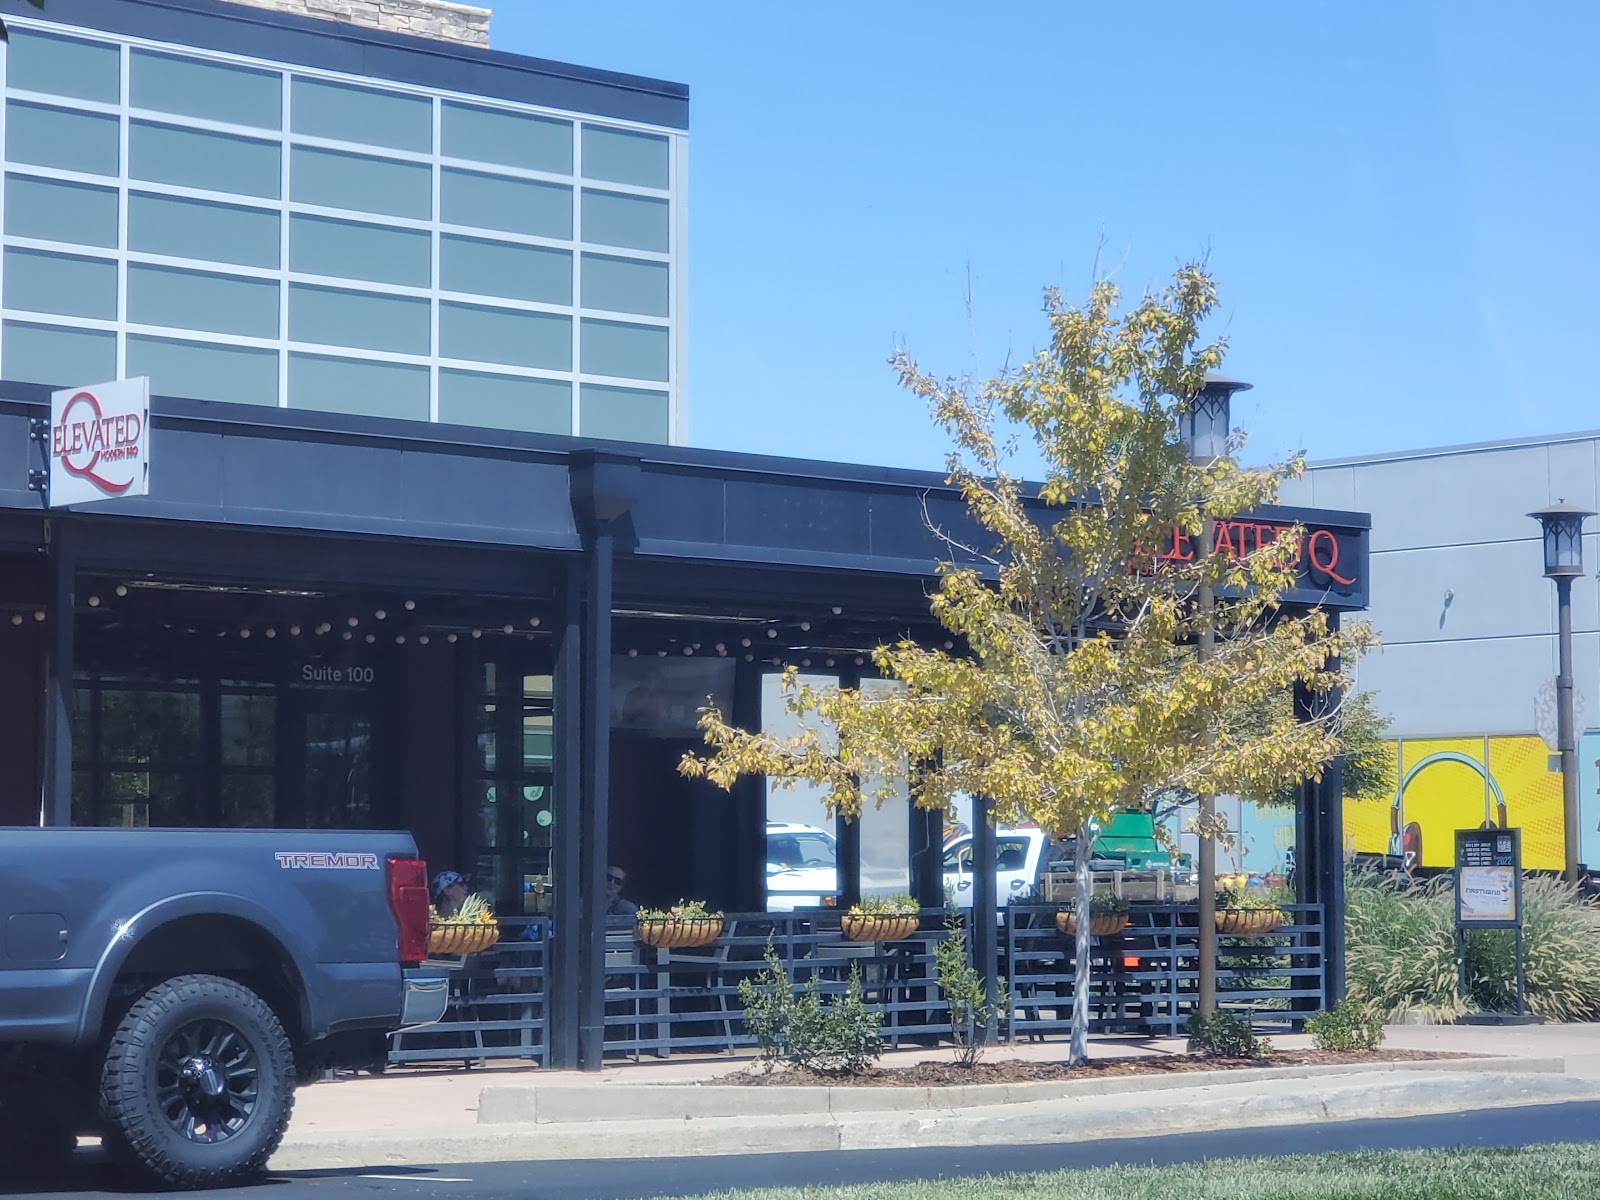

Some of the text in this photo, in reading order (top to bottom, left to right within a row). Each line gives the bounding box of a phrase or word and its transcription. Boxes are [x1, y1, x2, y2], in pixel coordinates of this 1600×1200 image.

[53, 414, 141, 456] ELEVATED
[1308, 529, 1357, 585] Q
[302, 664, 374, 683] Suite 100
[275, 852, 380, 870] TREMOR
[1496, 855, 1512, 866] 2022
